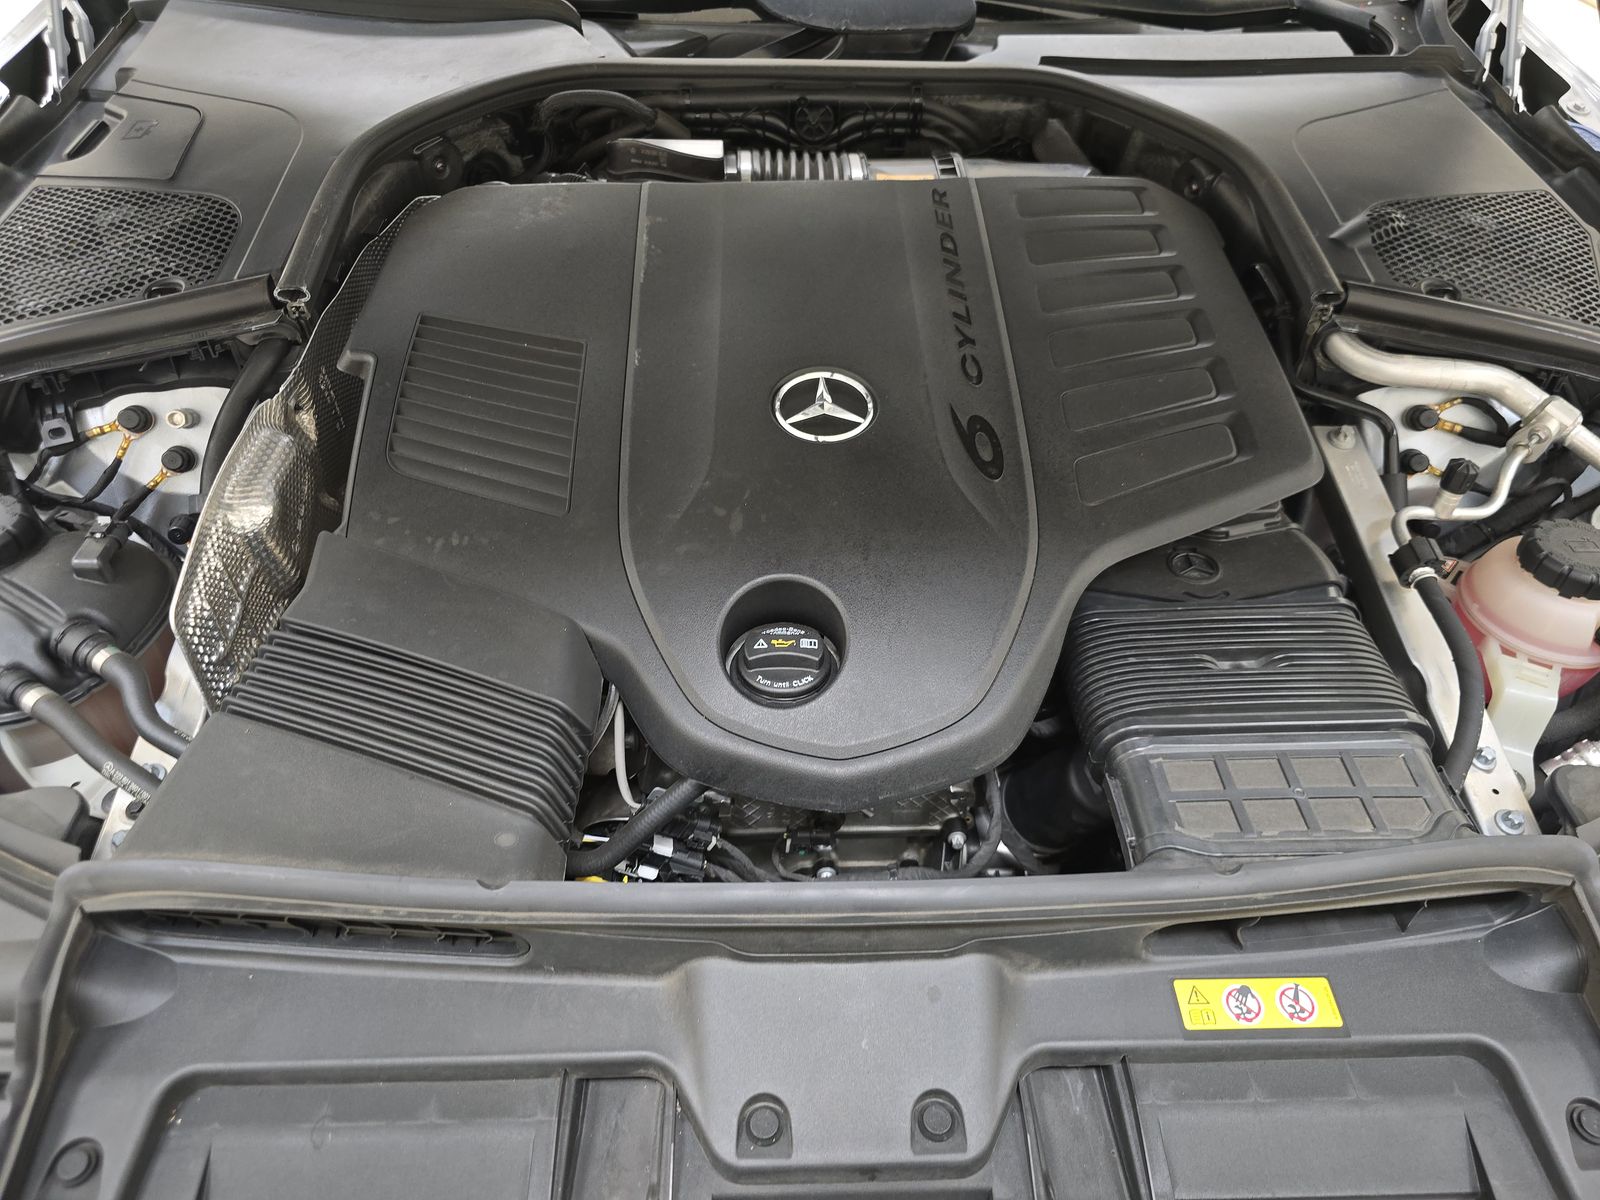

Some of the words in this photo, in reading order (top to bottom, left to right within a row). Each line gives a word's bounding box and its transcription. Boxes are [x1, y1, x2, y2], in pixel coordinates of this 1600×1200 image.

[931, 186, 984, 387] CYLINDER
[949, 401, 1004, 481] 6
[756, 674, 771, 687] Turn
[792, 674, 815, 687] CLICK
